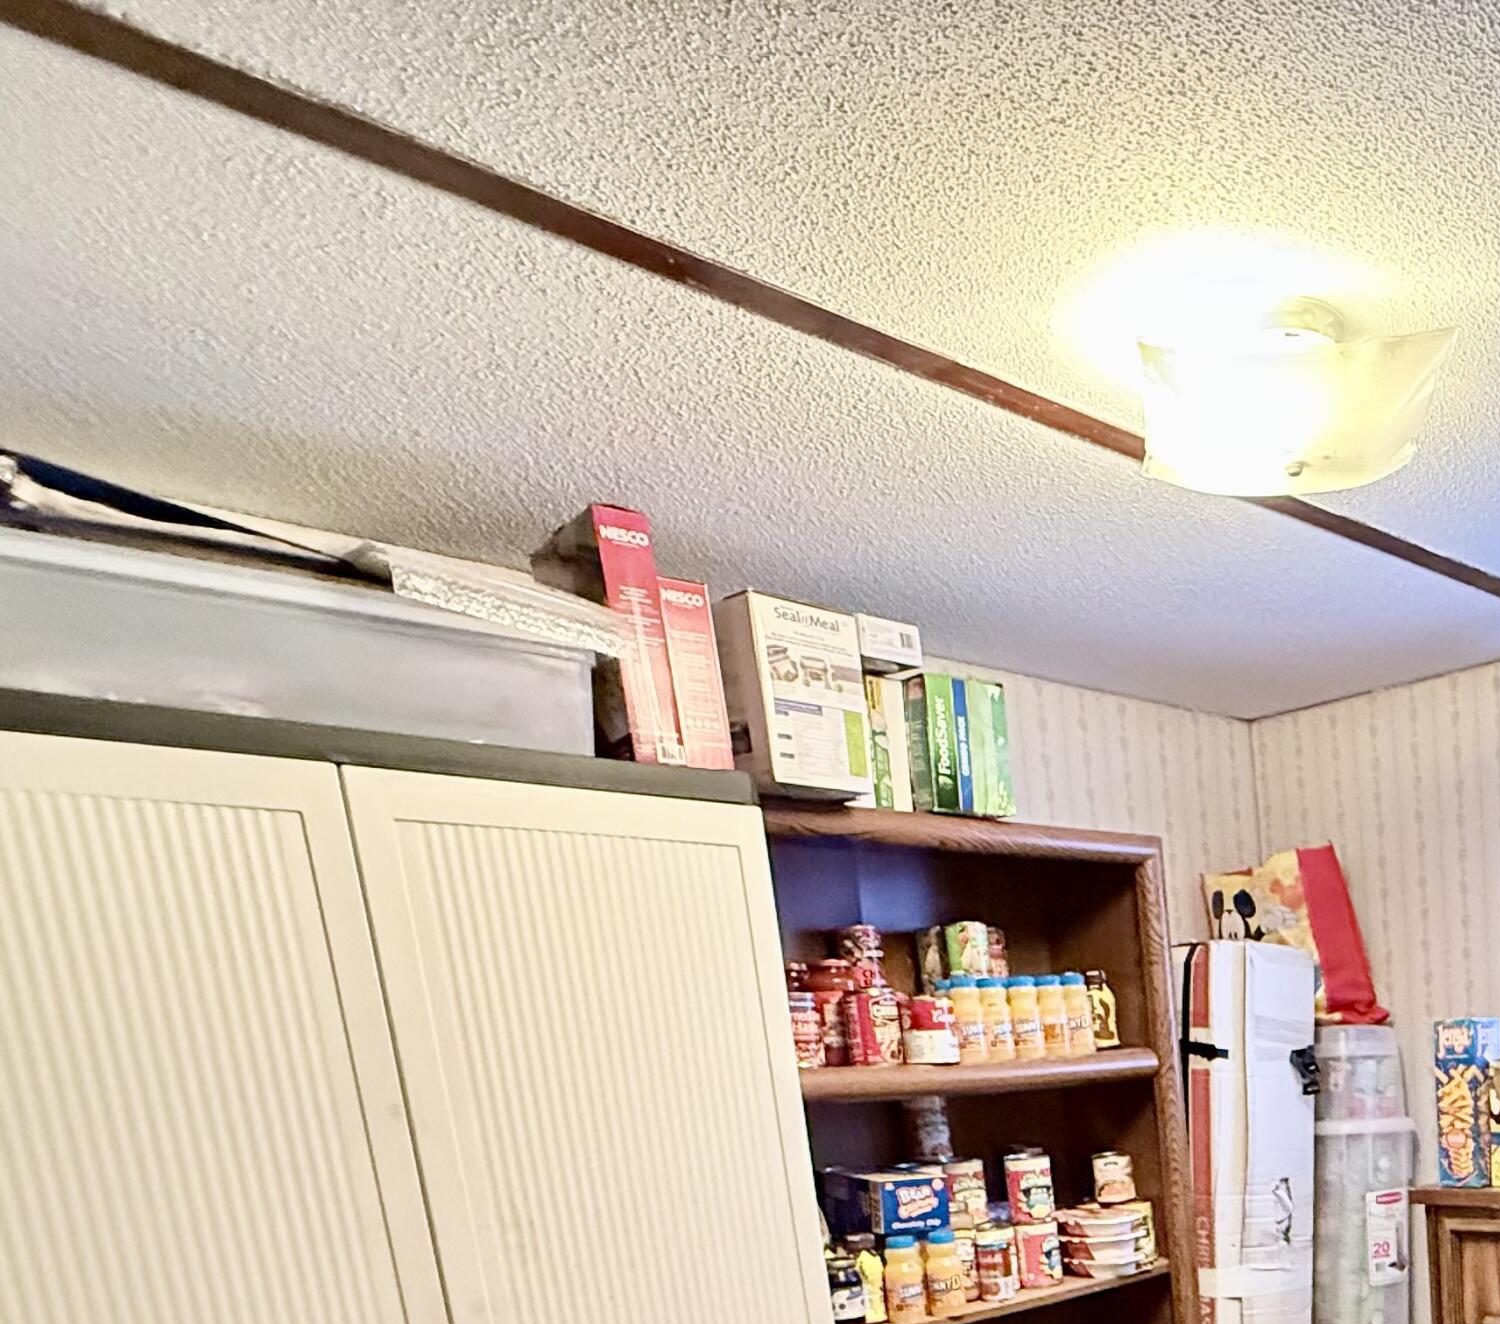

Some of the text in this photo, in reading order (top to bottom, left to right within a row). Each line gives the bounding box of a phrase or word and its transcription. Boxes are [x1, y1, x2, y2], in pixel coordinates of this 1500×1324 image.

[598, 524, 649, 547] NESCO
[659, 588, 704, 608] NESCO
[773, 606, 839, 633] Seal Meal
[934, 695, 951, 775] FoodSaver
[1437, 1024, 1473, 1060] Jenga
[1372, 1241, 1390, 1255] 20
